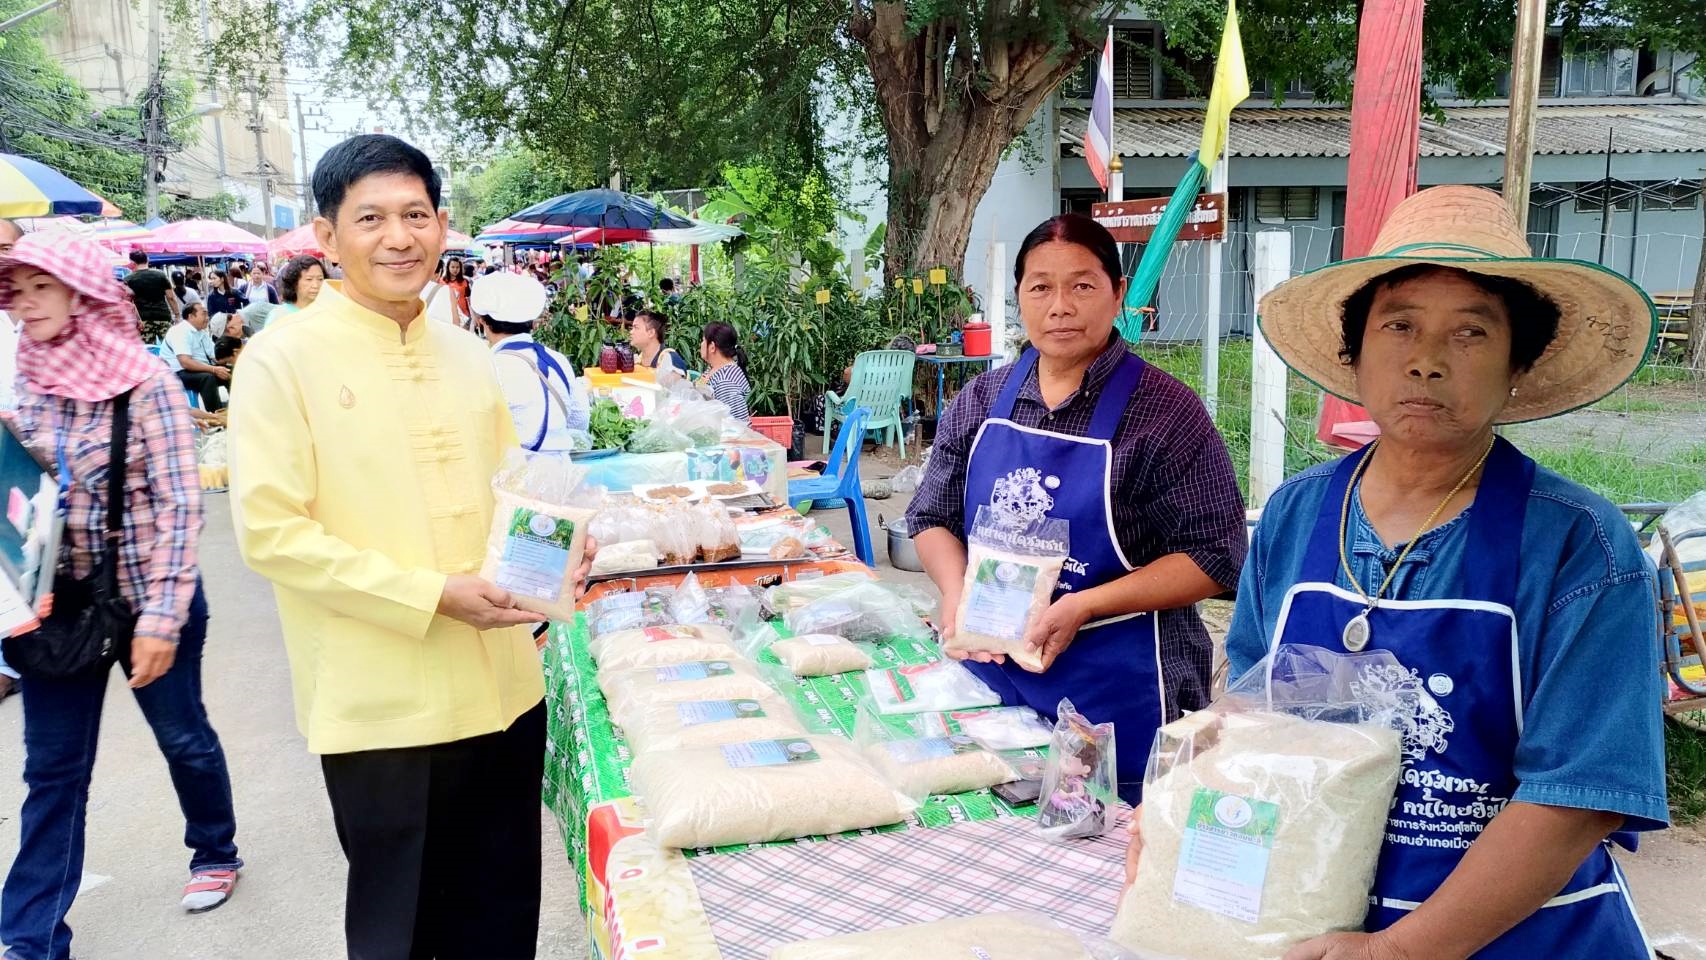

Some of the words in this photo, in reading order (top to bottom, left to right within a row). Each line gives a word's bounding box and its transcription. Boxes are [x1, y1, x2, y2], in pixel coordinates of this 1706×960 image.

[1387, 818, 1484, 837] าชการจังหวัดสุโขทัย
